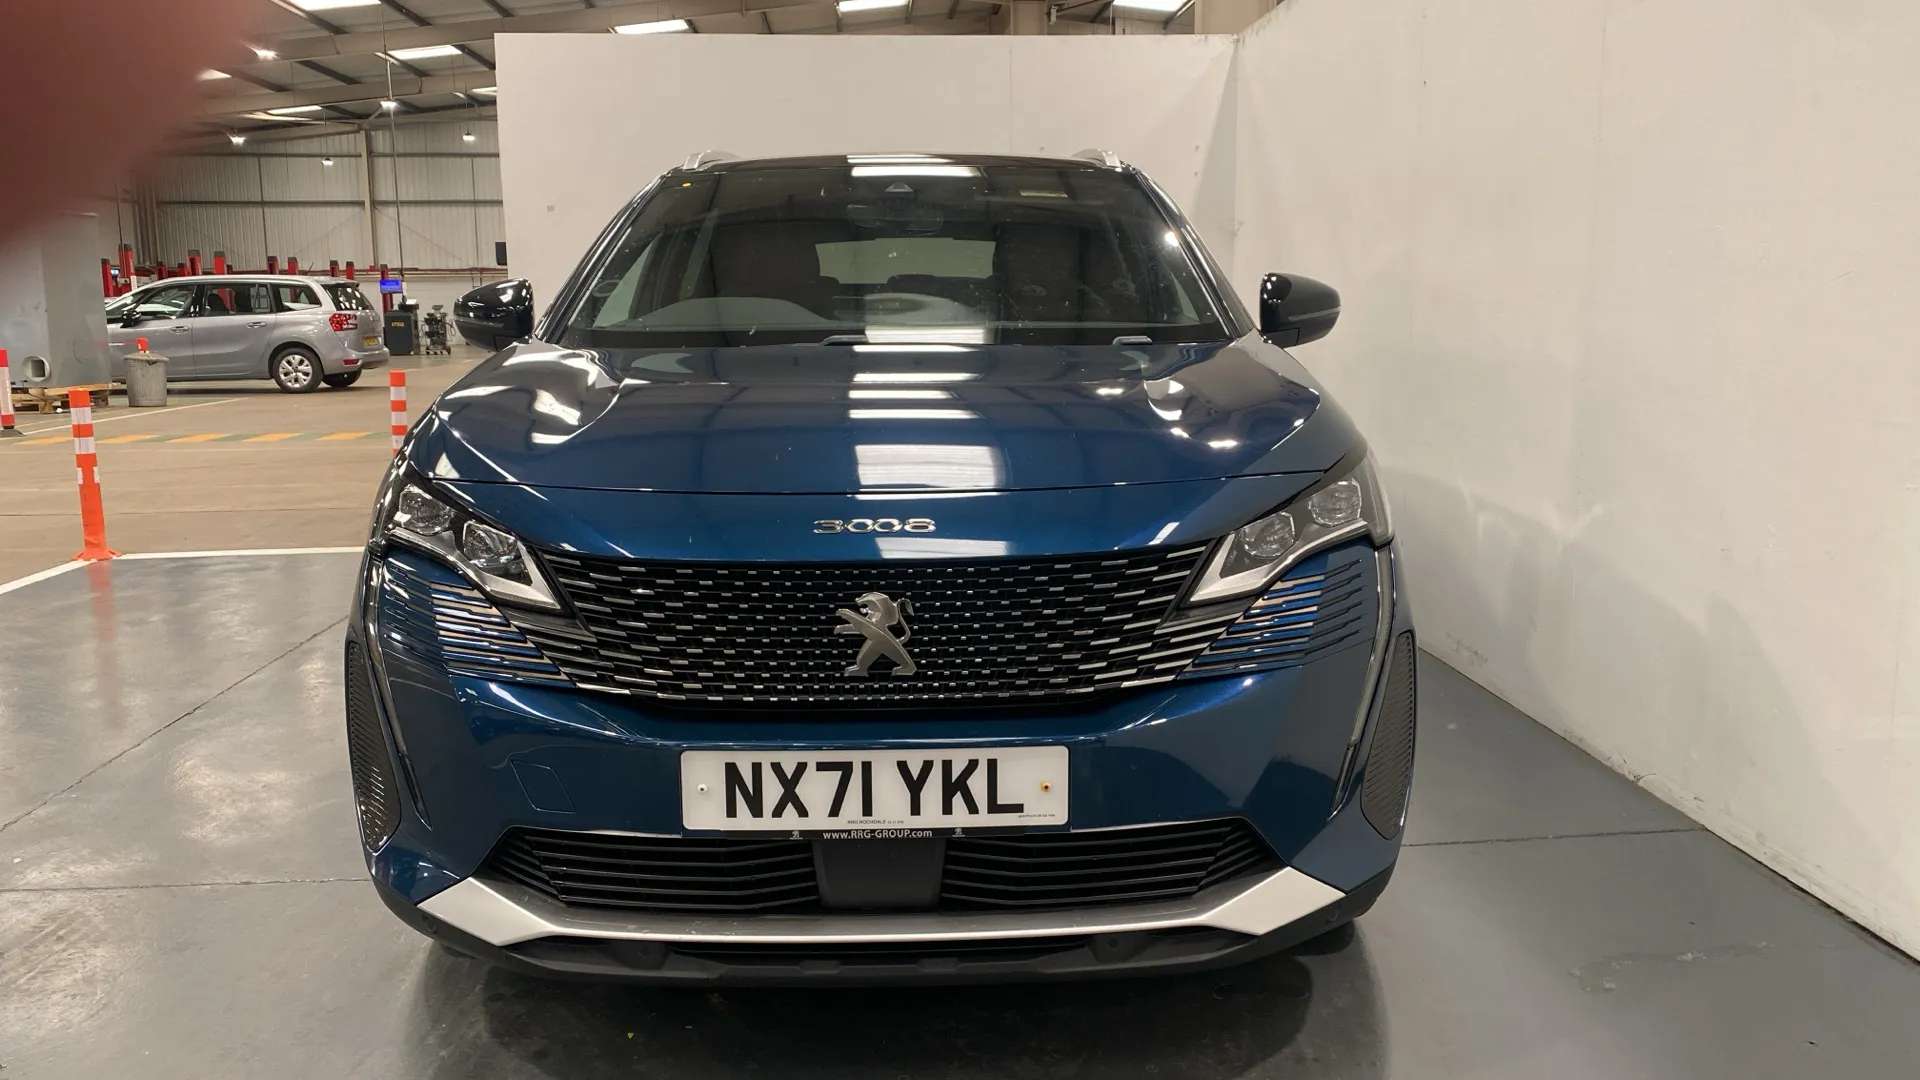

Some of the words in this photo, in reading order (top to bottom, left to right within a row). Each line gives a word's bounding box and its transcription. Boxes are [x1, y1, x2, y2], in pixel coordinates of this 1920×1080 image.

[813, 518, 937, 534] 3008
[724, 760, 873, 818] NX71
[896, 758, 1024, 816] YKL
[822, 829, 933, 839] www.RRG-GROUP.com
